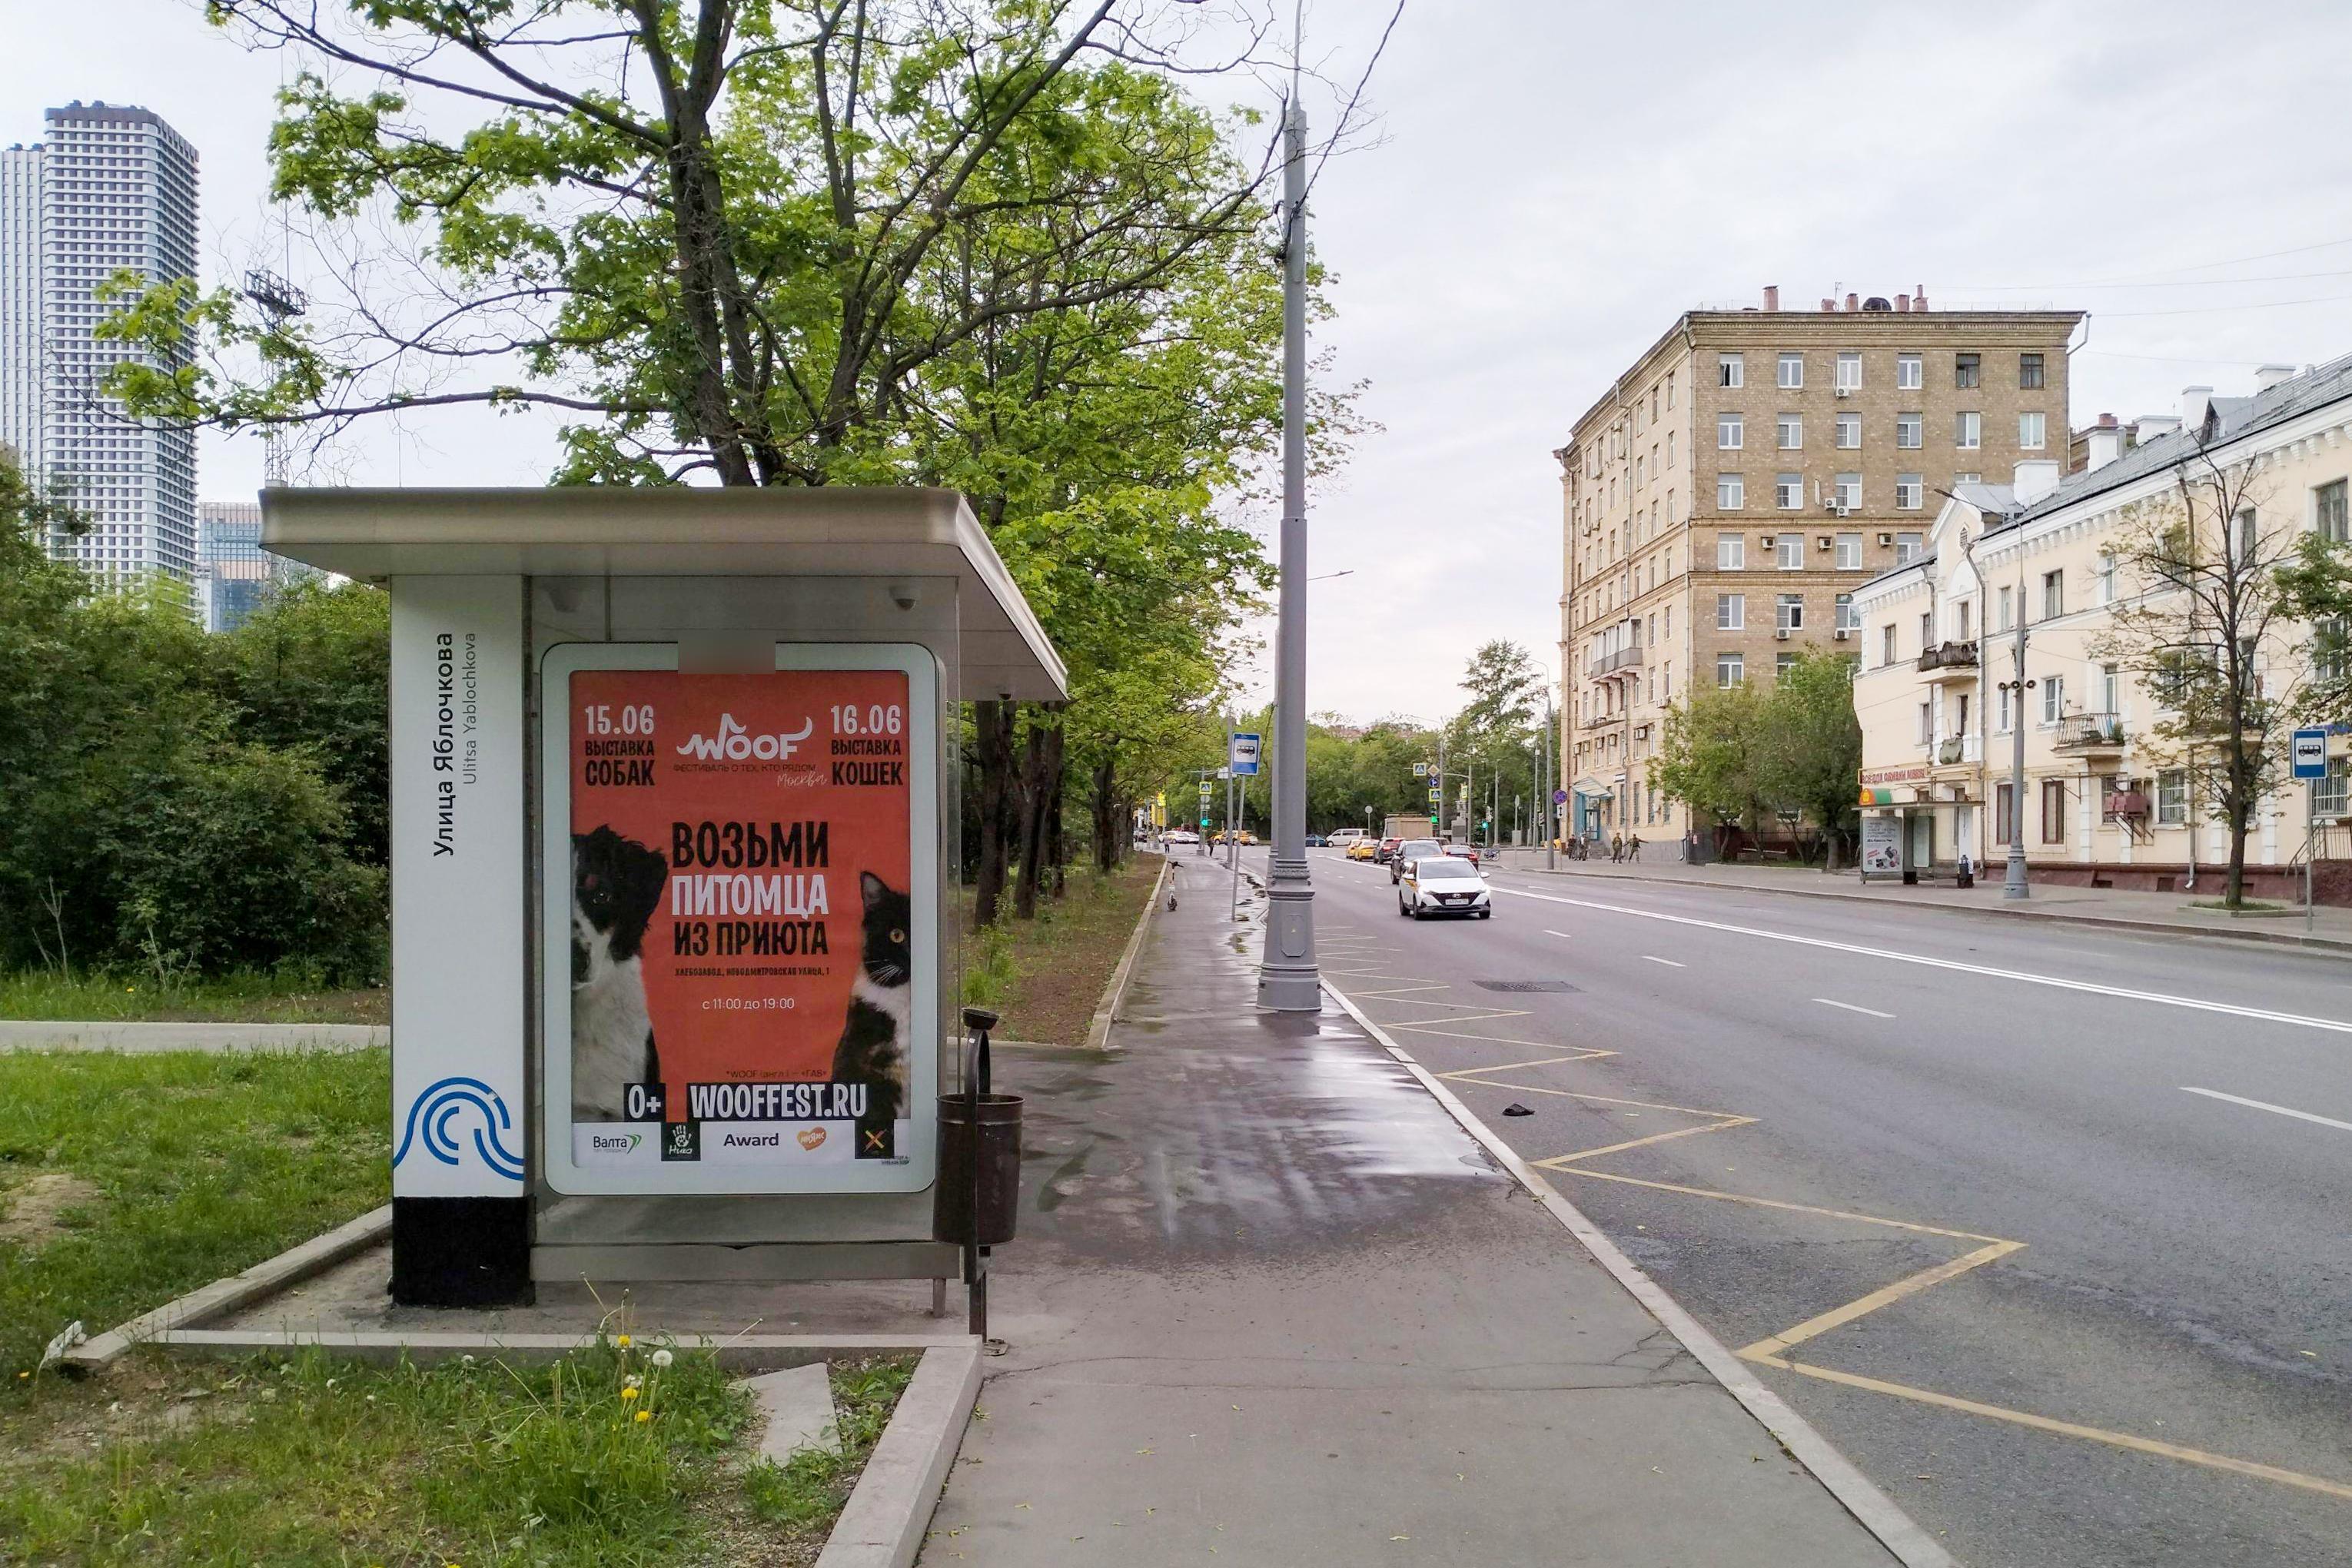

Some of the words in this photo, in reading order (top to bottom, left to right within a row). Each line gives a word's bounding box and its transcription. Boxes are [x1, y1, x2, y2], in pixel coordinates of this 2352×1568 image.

[461, 633, 477, 734] Yablochkova
[433, 633, 453, 772] Яблочкова
[585, 705, 655, 735] 15.06
[831, 705, 902, 735] 16.06
[585, 739, 655, 756] ВЫСТАВКА
[676, 713, 812, 759] WOOF
[832, 739, 902, 756] ВЫСТАВКА
[463, 739, 477, 785] Ulitsa
[585, 759, 656, 786] СОБАК
[673, 763, 729, 772] ФЕСТИВАЛЬ
[732, 763, 739, 772] О
[762, 763, 779, 772] КТО
[782, 763, 817, 772] РЯДОМ
[832, 760, 903, 786] КОШЕК
[777, 771, 828, 787] Москва
[433, 781, 456, 857] Улица
[671, 822, 829, 869] ВОЗЬМИ
[671, 874, 829, 920] ПИТОМЦА
[673, 922, 709, 956] ИЗ
[716, 921, 829, 956] ПРИЮТА
[713, 998, 741, 1009] 11:00
[744, 1001, 760, 1009] до
[763, 998, 795, 1009] 19:00
[628, 1084, 661, 1118] 0+
[690, 1083, 867, 1118] WOOFFEST.RU
[593, 1136, 627, 1148] Валта
[669, 1144, 693, 1155] Ника
[723, 1133, 779, 1147] Award
